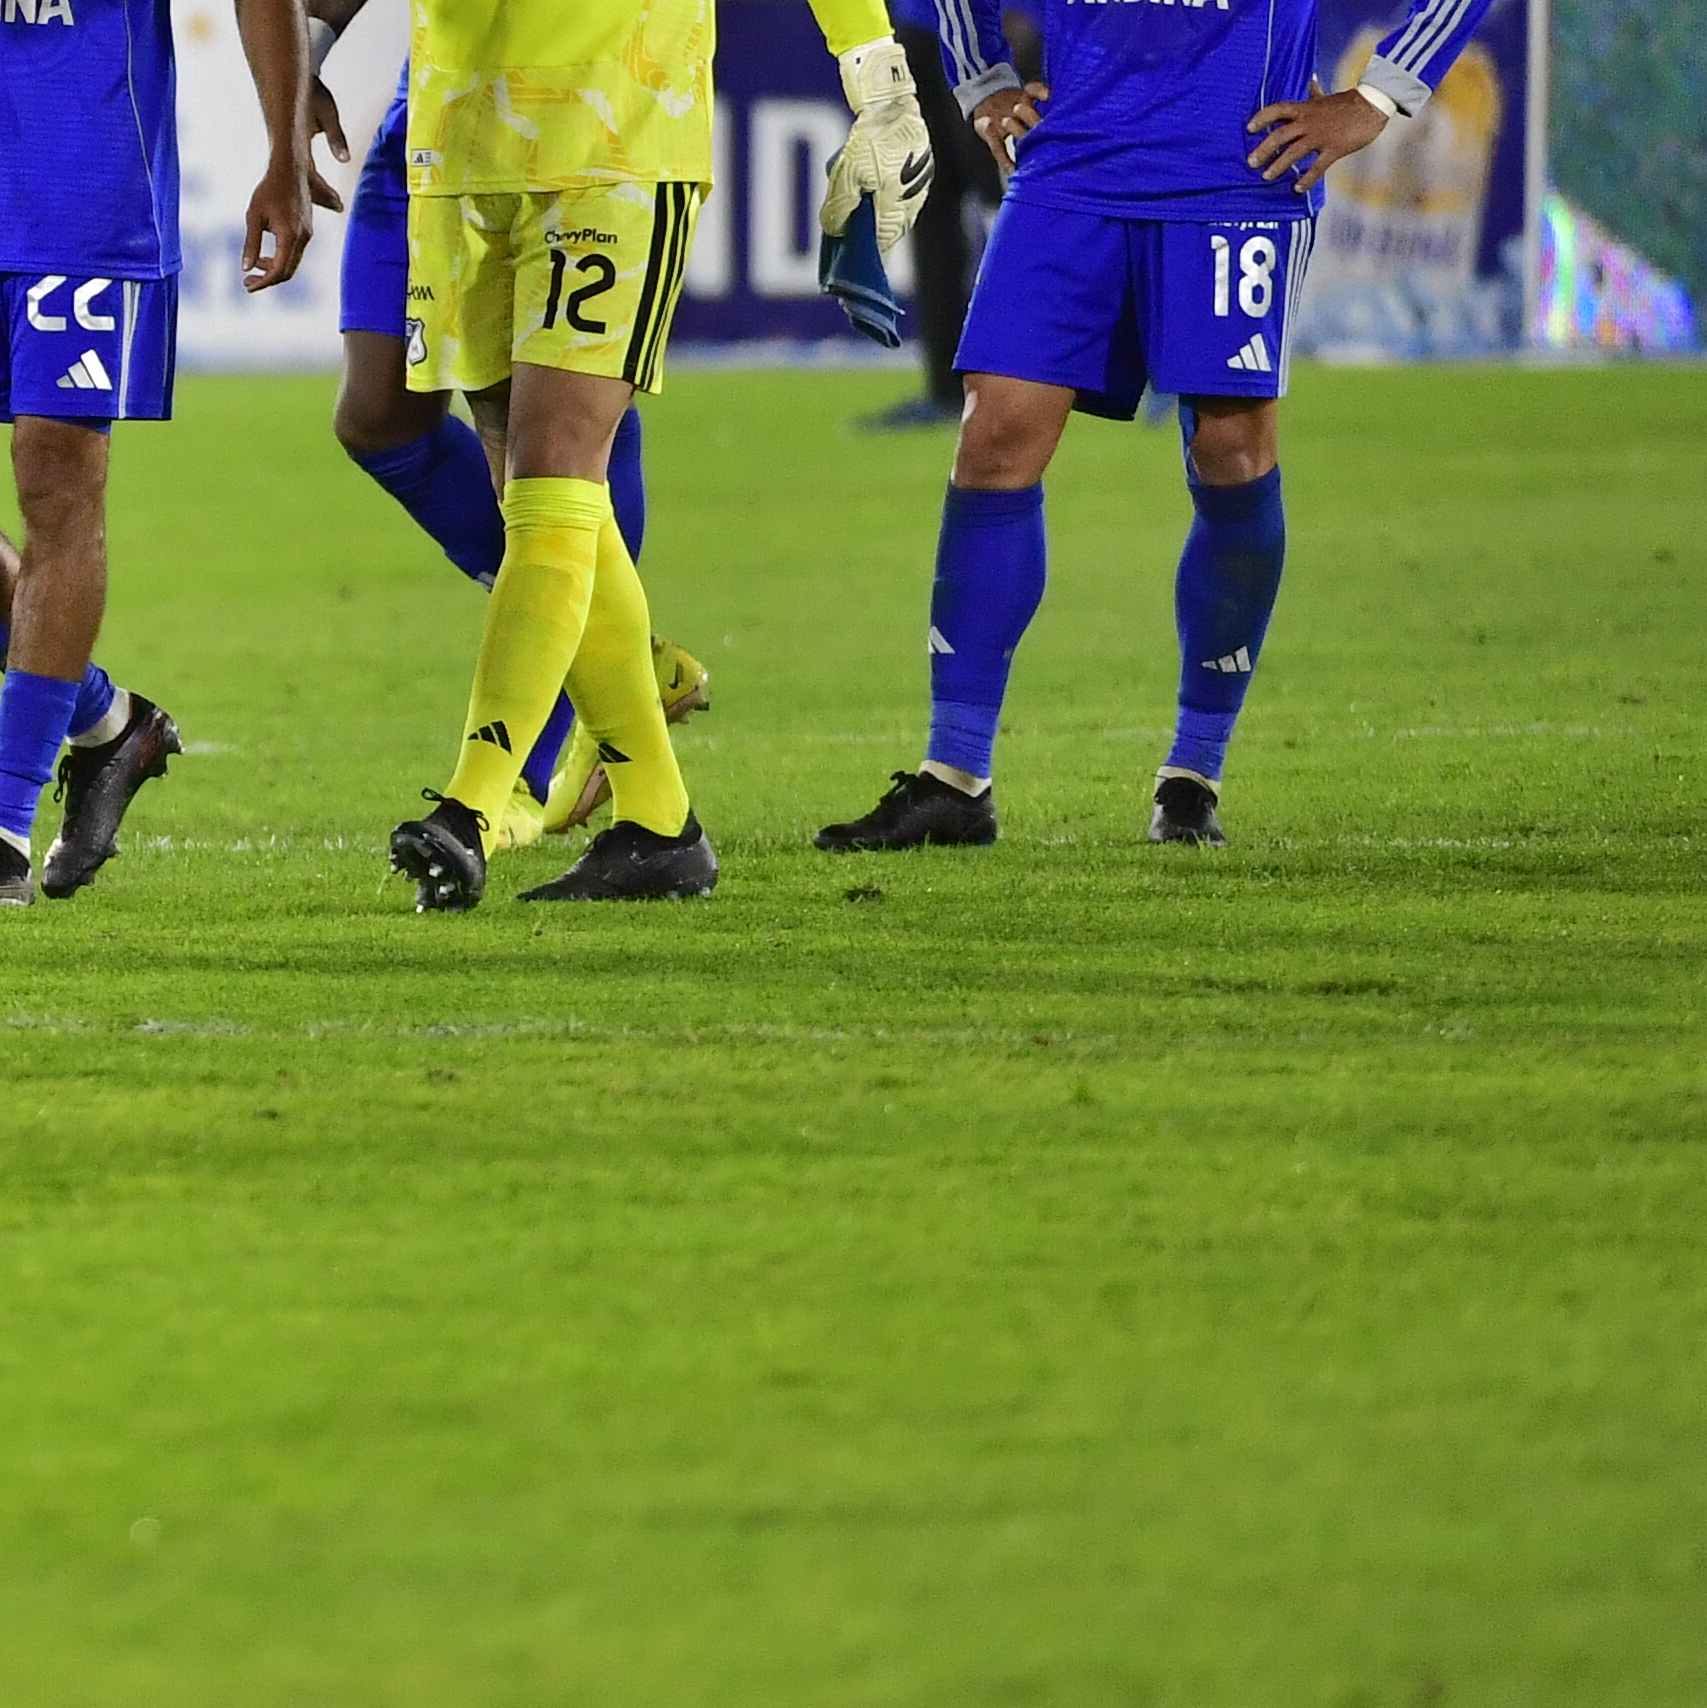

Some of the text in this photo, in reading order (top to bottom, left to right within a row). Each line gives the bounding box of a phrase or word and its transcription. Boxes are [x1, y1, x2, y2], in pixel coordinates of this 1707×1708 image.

[544, 227, 619, 246] ChevyPlan
[1210, 234, 1278, 319] 18
[542, 248, 617, 335] 12
